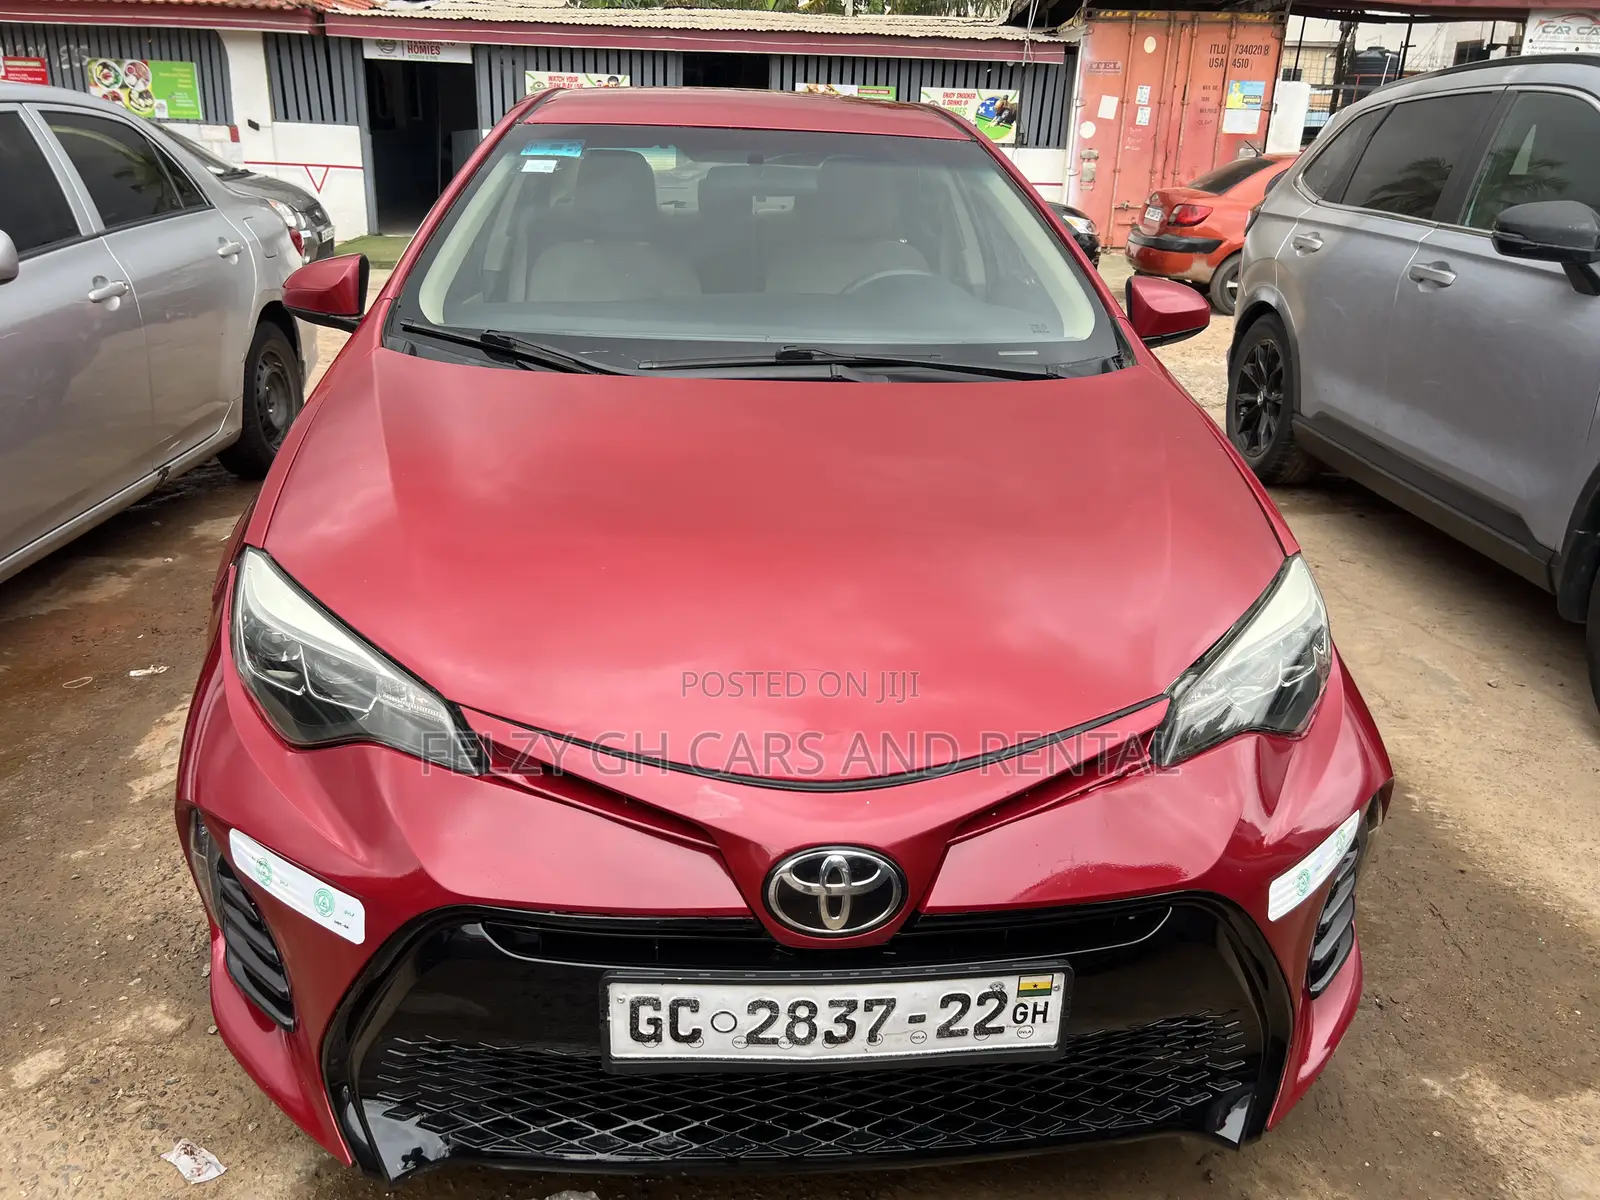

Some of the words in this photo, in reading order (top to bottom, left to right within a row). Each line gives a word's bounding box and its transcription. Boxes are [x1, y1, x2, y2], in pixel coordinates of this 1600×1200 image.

[1542, 25, 1571, 35] CAR
[1577, 26, 1600, 35] CA
[407, 44, 441, 55] HOMIES
[1209, 43, 1226, 55] ITLU
[1208, 58, 1224, 68] USA
[1231, 58, 1250, 69] 4510
[1012, 1001, 1049, 1025] GH
[629, 995, 703, 1044] GC
